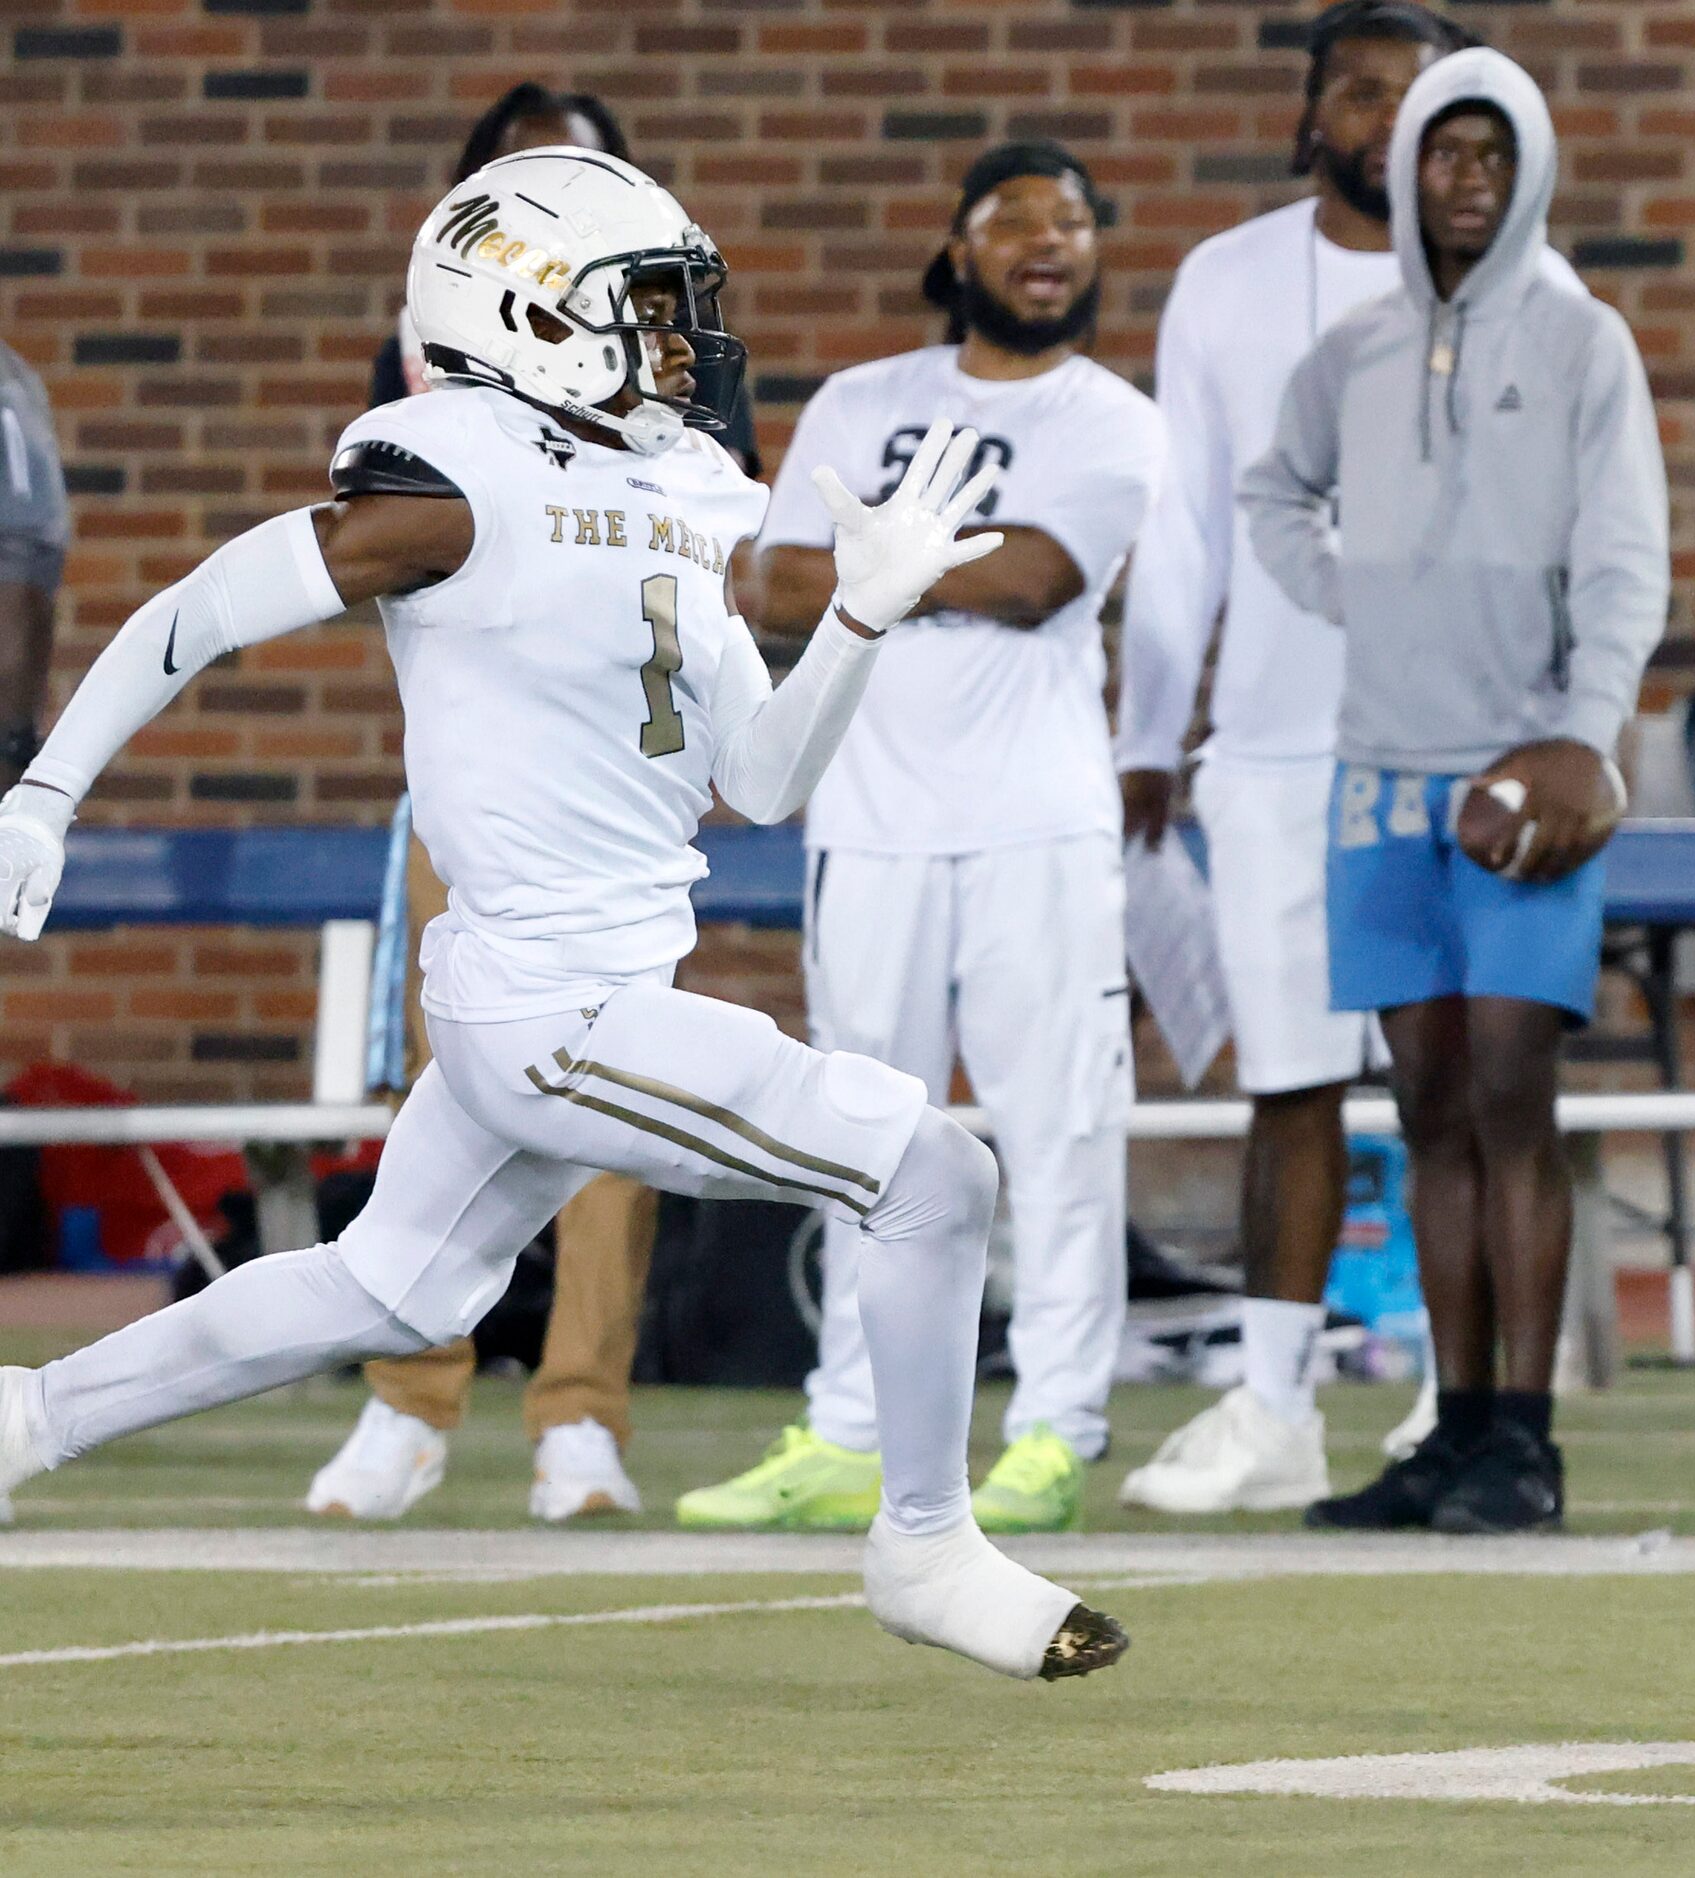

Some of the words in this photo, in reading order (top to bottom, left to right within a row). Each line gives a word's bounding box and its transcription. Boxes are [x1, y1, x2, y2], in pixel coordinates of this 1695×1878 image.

[545, 504, 627, 548] THE
[647, 513, 726, 576] MECCA
[639, 572, 686, 759] 1
